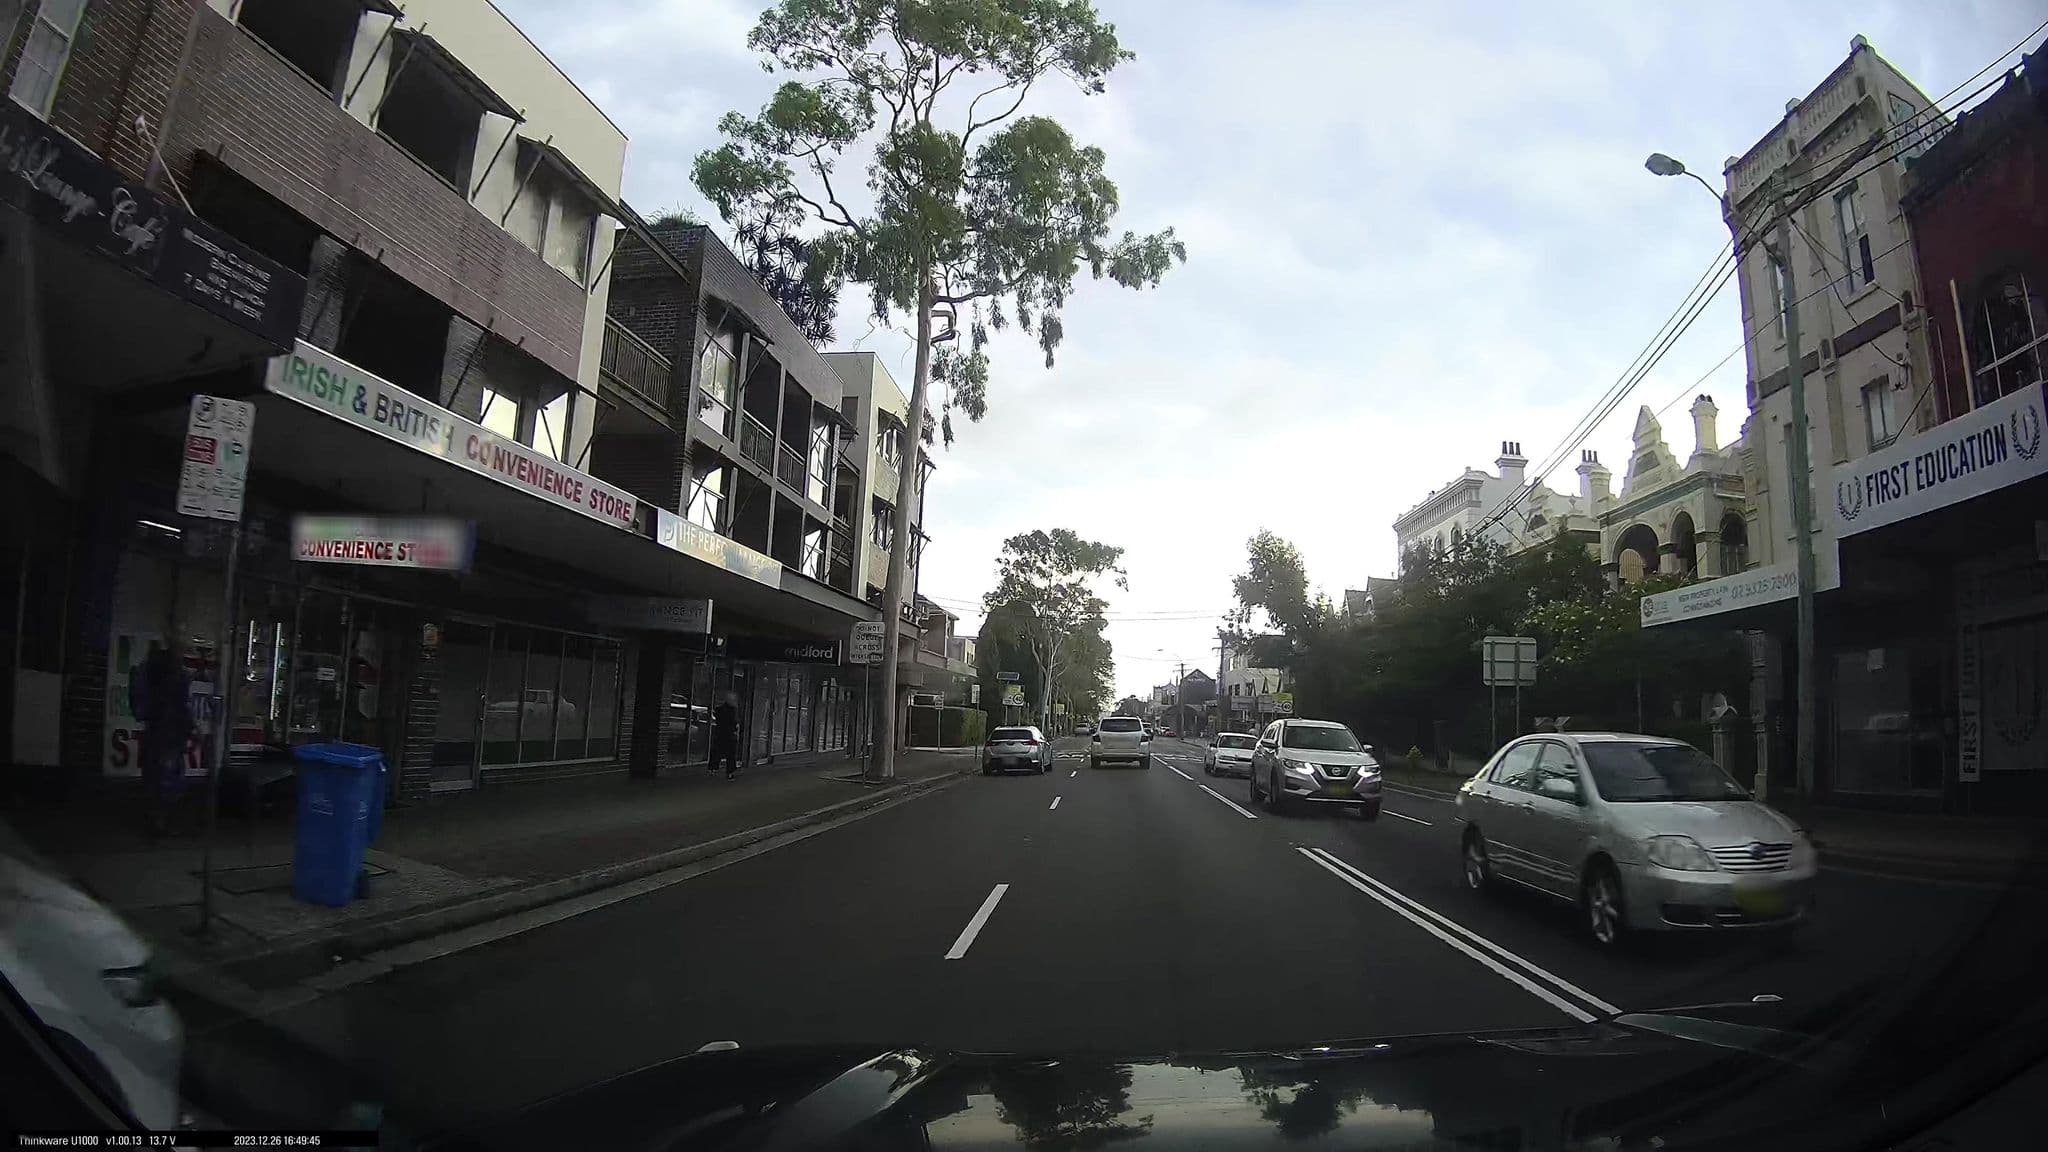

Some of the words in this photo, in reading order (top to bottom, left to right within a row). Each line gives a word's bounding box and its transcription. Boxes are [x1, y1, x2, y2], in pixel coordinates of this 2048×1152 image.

[282, 352, 348, 406] IRISH
[352, 384, 367, 416] &
[373, 392, 455, 452] BRITISH
[466, 434, 584, 504] CONVENIENCE
[589, 488, 632, 523] STORE
[1866, 461, 1909, 507] FIRST
[1915, 423, 2008, 491] EDUCATION
[679, 522, 695, 546] THE
[300, 539, 393, 561] CONVENIENCE
[784, 645, 833, 659] midford
